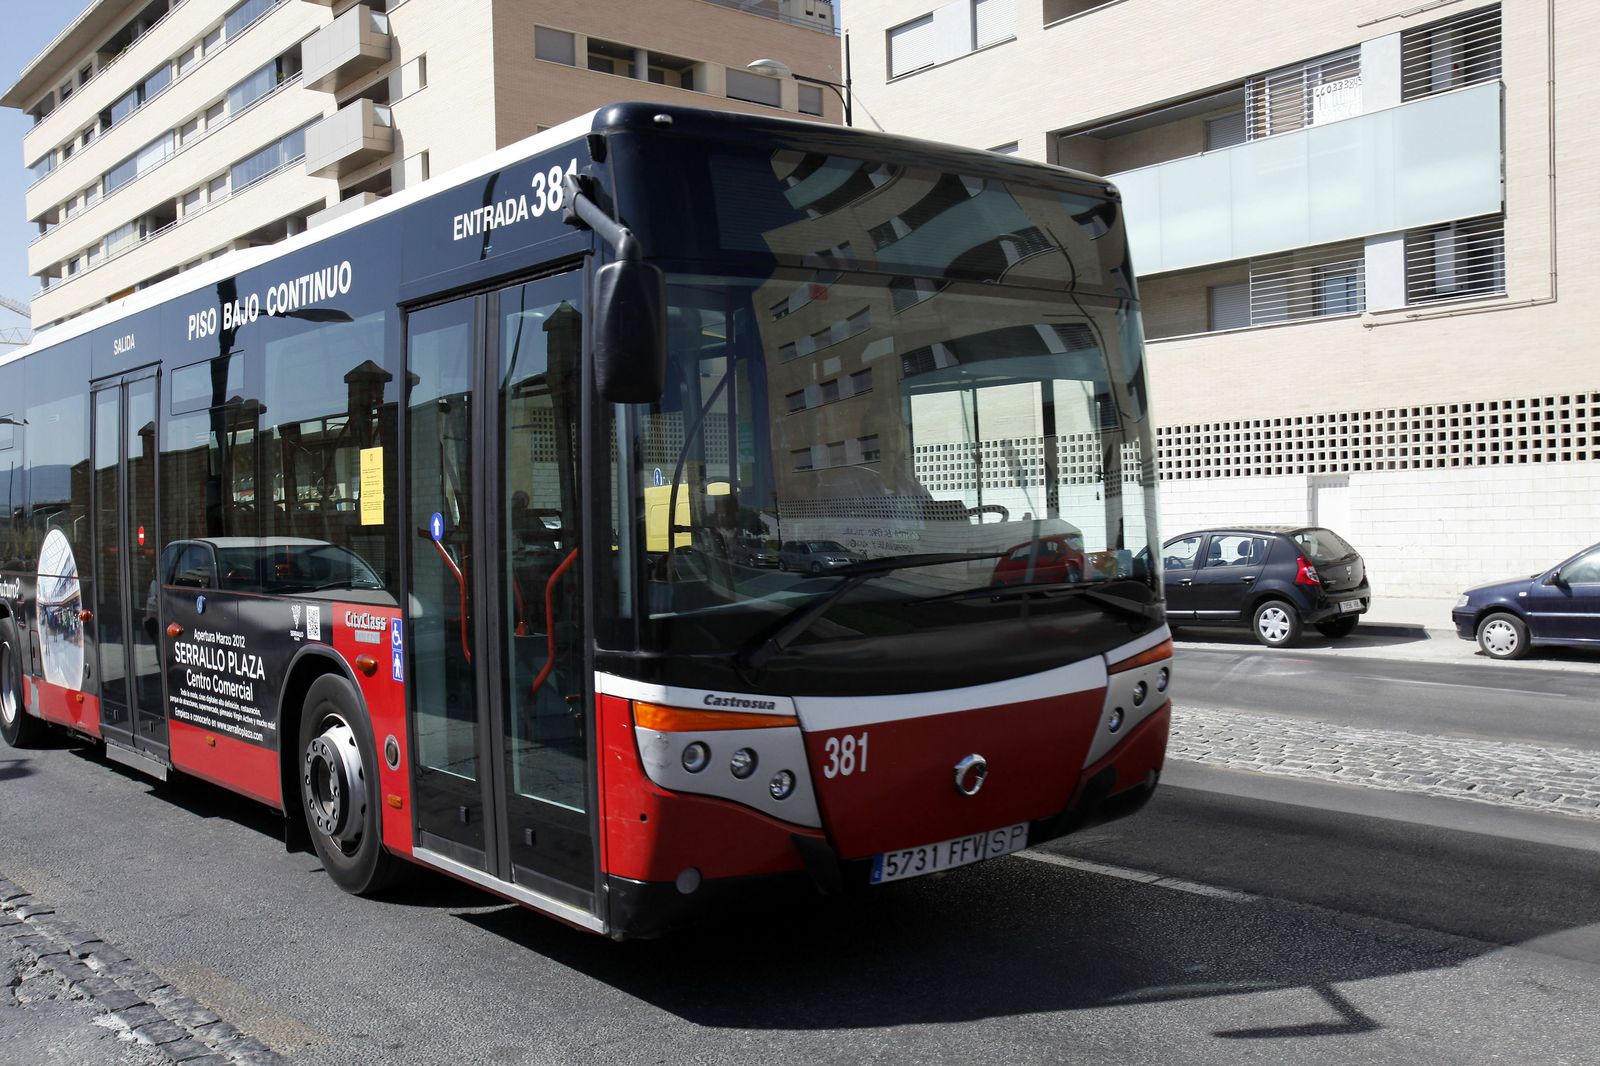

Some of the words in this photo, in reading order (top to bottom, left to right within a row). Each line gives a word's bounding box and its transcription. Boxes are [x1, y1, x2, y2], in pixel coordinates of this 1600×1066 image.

[453, 194, 529, 241] ENTRADA
[188, 307, 217, 341] PISO
[223, 293, 259, 330] BAJO
[266, 260, 352, 317] CONTINUO
[113, 333, 136, 356] SALIDA
[0, 574, 20, 599] uturo?
[345, 610, 387, 631] CityClass
[193, 628, 216, 643] Apertura
[215, 631, 232, 646] Marzo
[232, 634, 246, 648] 2012
[174, 641, 225, 672] SERRALLO
[227, 651, 266, 681] PLAZA
[186, 668, 212, 691] Centro
[212, 674, 254, 702] Comercial
[703, 694, 776, 710] Castrosua
[216, 720, 264, 742] www.serralloplaza.com
[823, 731, 868, 779] 381
[886, 845, 938, 877] 5731
[950, 835, 984, 865] FFV
